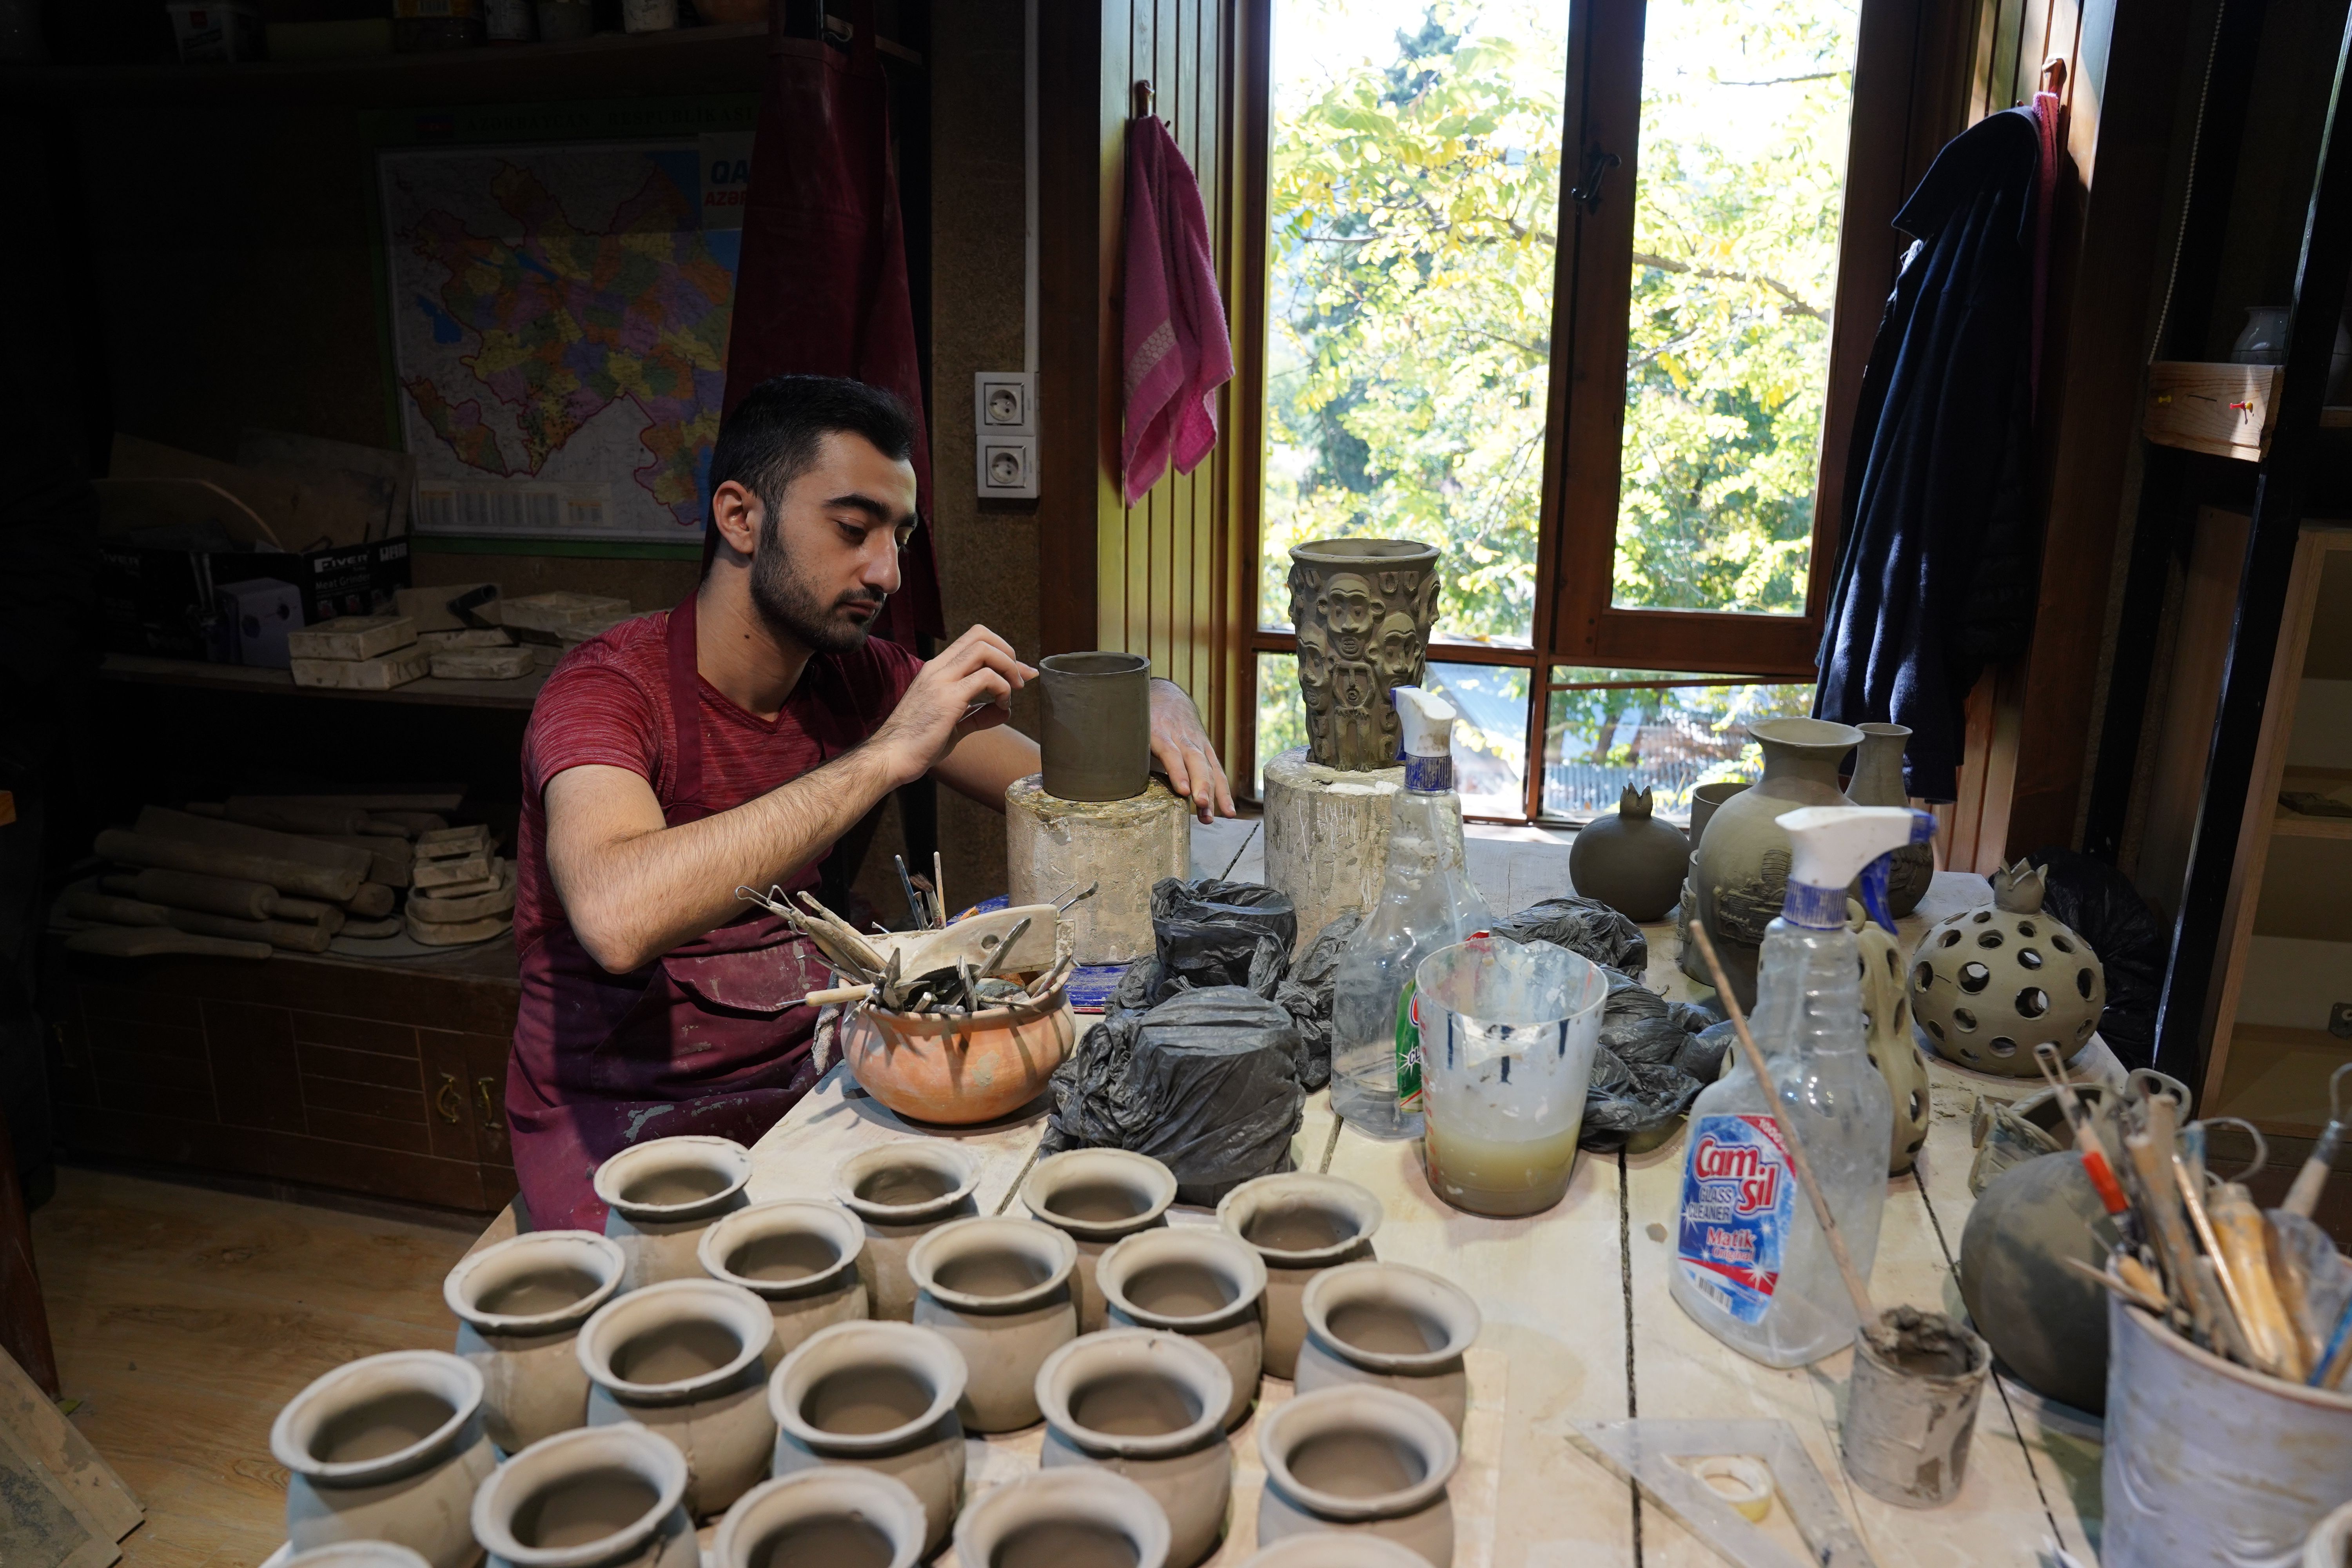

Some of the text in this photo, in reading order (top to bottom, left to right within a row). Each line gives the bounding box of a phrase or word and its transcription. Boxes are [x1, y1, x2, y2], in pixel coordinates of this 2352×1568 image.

[1695, 1140, 1758, 1178] Cam
[1699, 1186, 1732, 1203] GLASS
[1739, 1166, 1776, 1211] Sil
[1688, 1203, 1730, 1220] CLEANER
[1707, 1227, 1757, 1248] Matik
